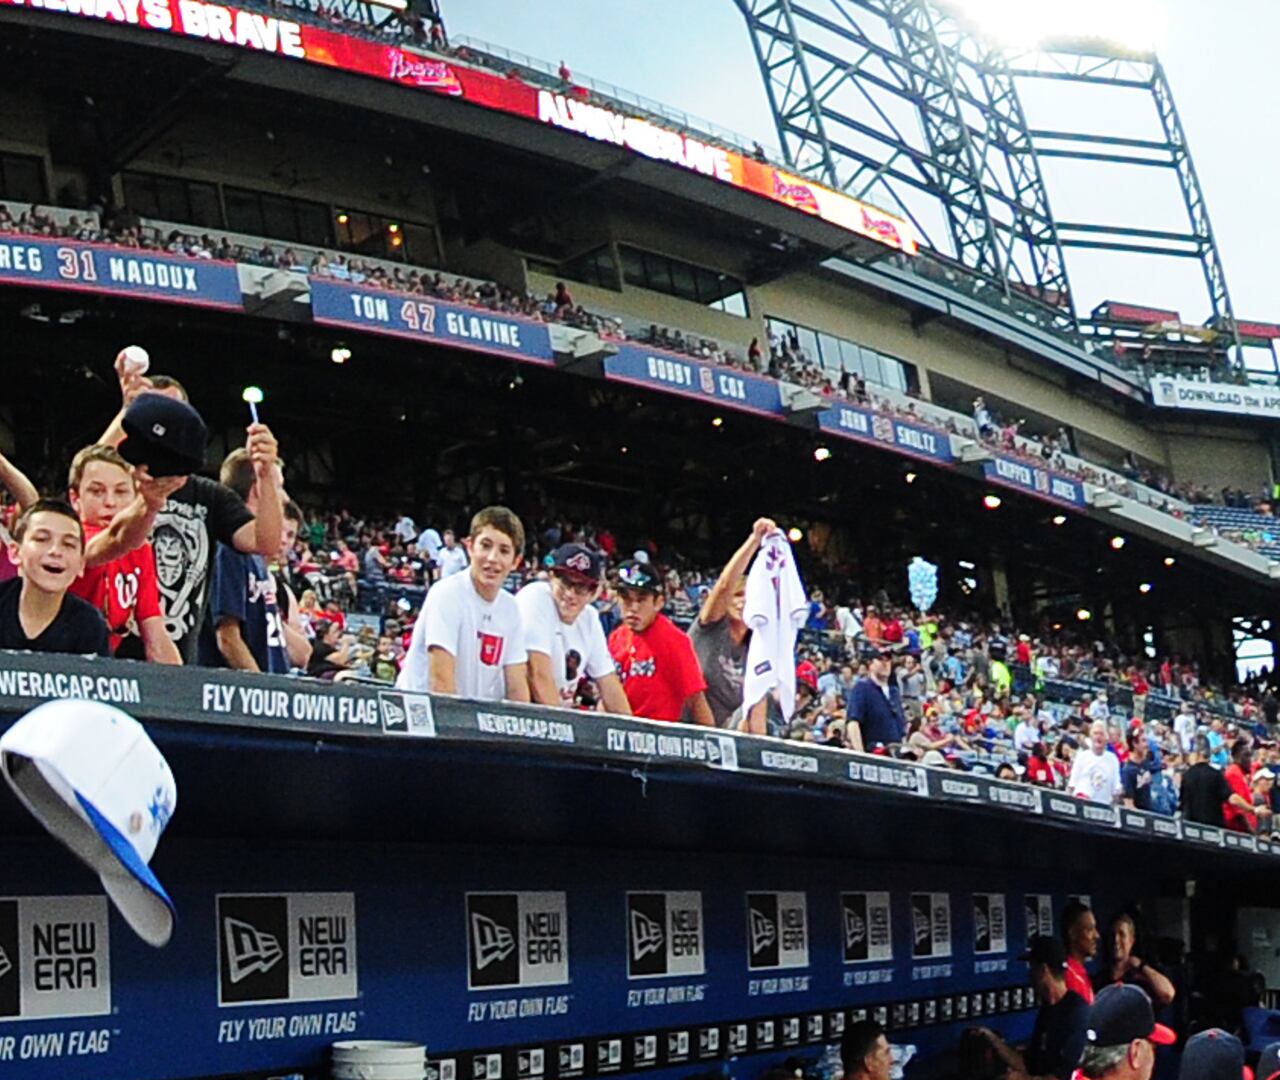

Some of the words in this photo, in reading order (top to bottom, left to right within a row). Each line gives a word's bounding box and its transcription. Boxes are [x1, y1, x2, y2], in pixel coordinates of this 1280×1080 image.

[179, 1, 305, 59] BRAVE
[56, 247, 97, 281] 31
[109, 256, 198, 292] MADDUX
[351, 293, 390, 323] TOM
[400, 300, 436, 333] 47
[447, 313, 521, 348] GLAVINE
[719, 375, 746, 399] COX
[203, 684, 236, 713] FLY
[239, 687, 289, 718] YOUR
[293, 693, 335, 723] OWN
[339, 698, 378, 725] FLAG
[476, 712, 575, 744] NEWERACAP.COM
[298, 916, 346, 945] NEW
[525, 912, 560, 938] NEW
[670, 909, 698, 932] NEW
[32, 921, 96, 957] NEW
[526, 939, 561, 964] ERA
[671, 933, 699, 957] ERA
[34, 956, 98, 992] ERA
[299, 947, 347, 977] ERA
[468, 1001, 486, 1022] FLY
[490, 999, 517, 1020] YOUR
[519, 997, 542, 1018] OWN
[544, 995, 568, 1016] FLAG
[218, 1019, 242, 1044] FLY
[248, 1016, 286, 1042] YOUR
[288, 1013, 323, 1038] OWN
[325, 1010, 357, 1035] FLAG
[20, 1032, 64, 1059] OWN
[68, 1029, 110, 1055] FLAG
